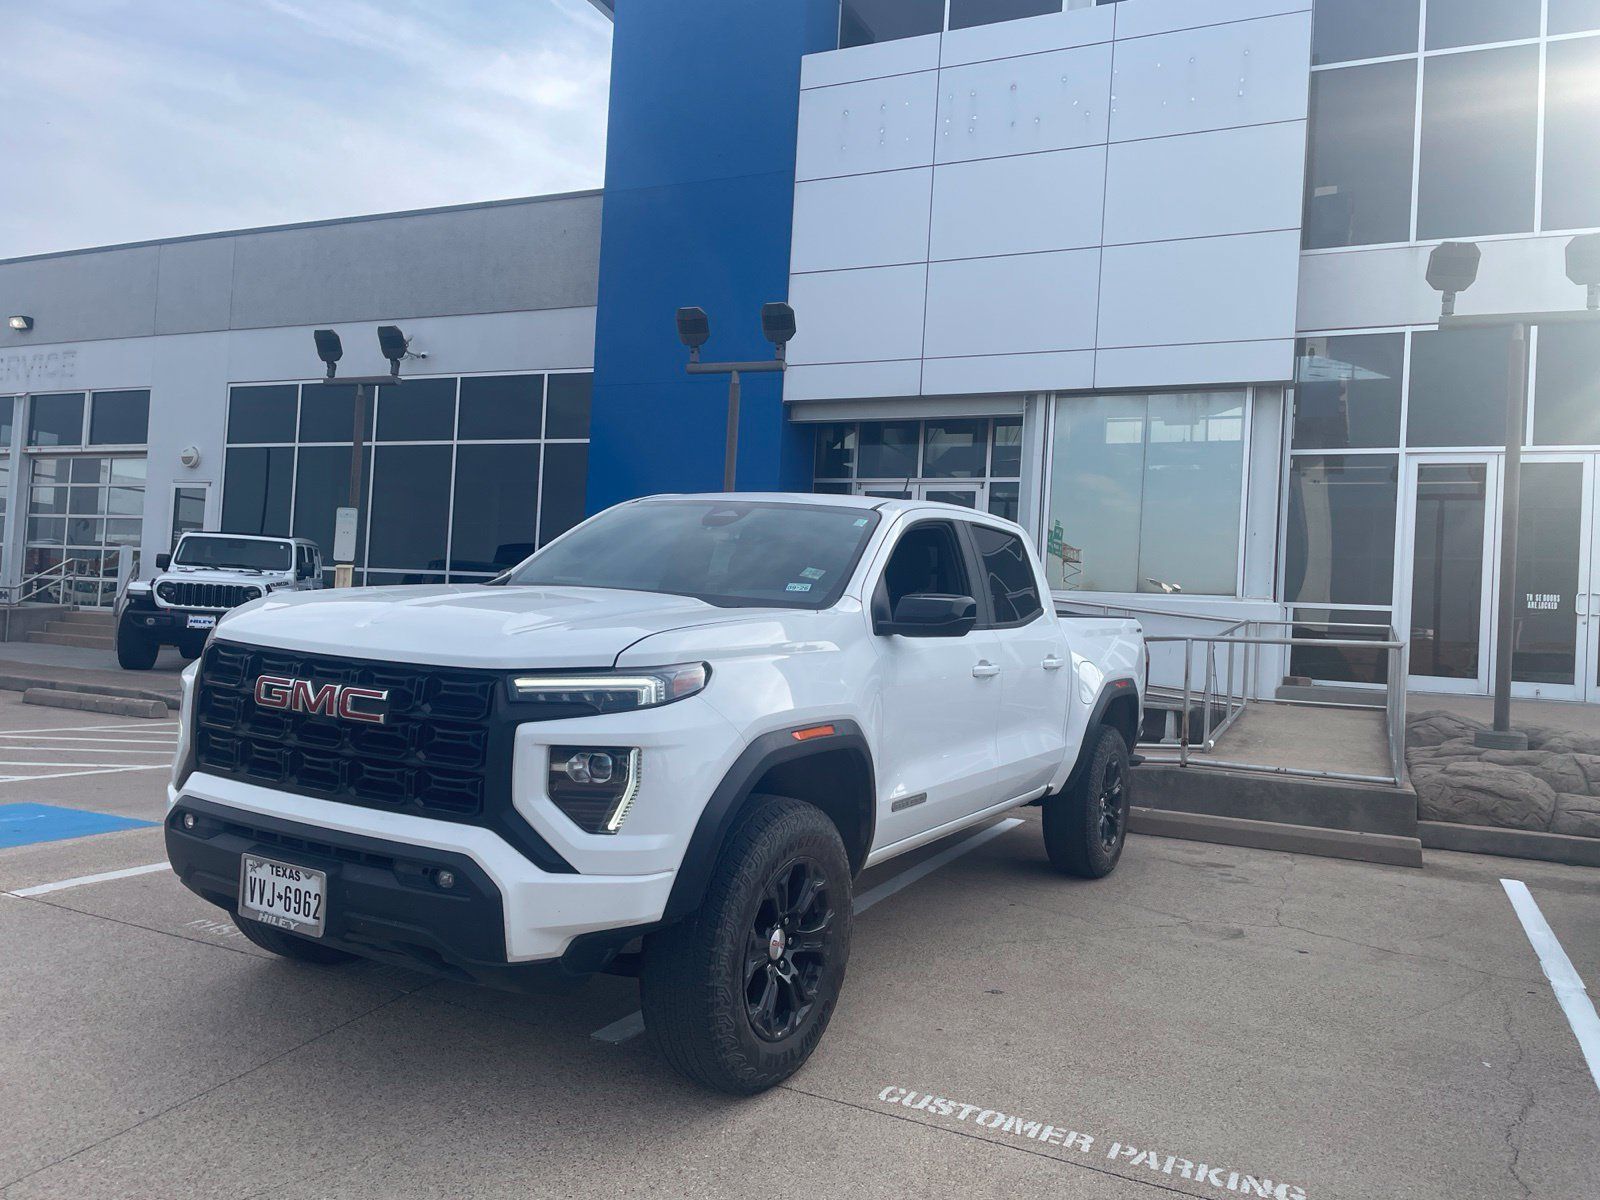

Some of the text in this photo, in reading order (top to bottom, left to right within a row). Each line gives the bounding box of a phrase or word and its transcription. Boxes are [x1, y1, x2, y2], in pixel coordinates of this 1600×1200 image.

[1527, 601, 1557, 609] ARE LOCKED
[1543, 594, 1560, 602] DOORS
[254, 675, 388, 724] GMC
[269, 864, 301, 882] TEXAS
[258, 912, 299, 930] HILEY
[878, 1086, 1307, 1200] CUSTOMER PARKING
